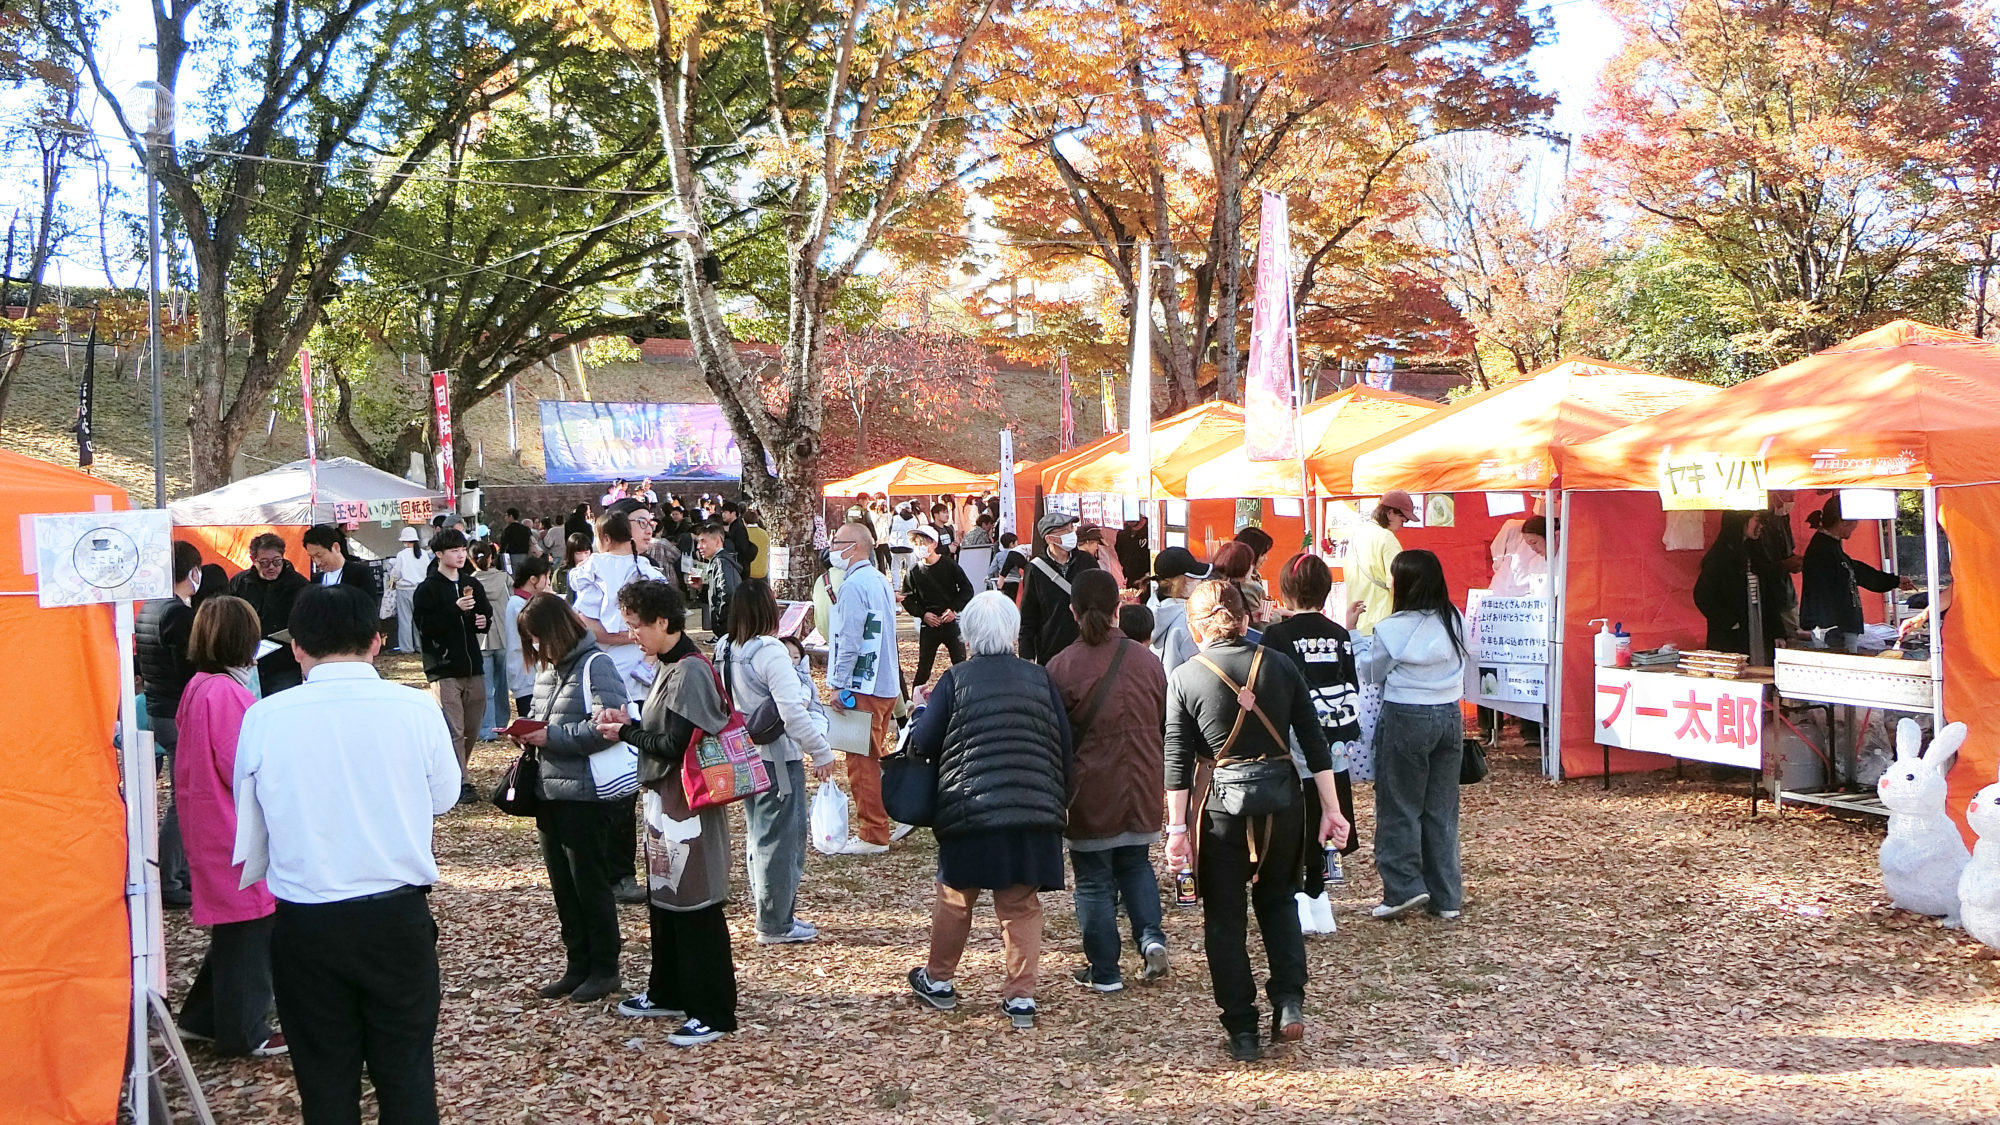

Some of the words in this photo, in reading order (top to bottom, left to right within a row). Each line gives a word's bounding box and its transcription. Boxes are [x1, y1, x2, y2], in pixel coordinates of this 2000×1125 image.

[594, 448, 678, 466] WINTER
[336, 502, 368, 520] 玉せん
[1597, 681, 1758, 749] ブー太郎
